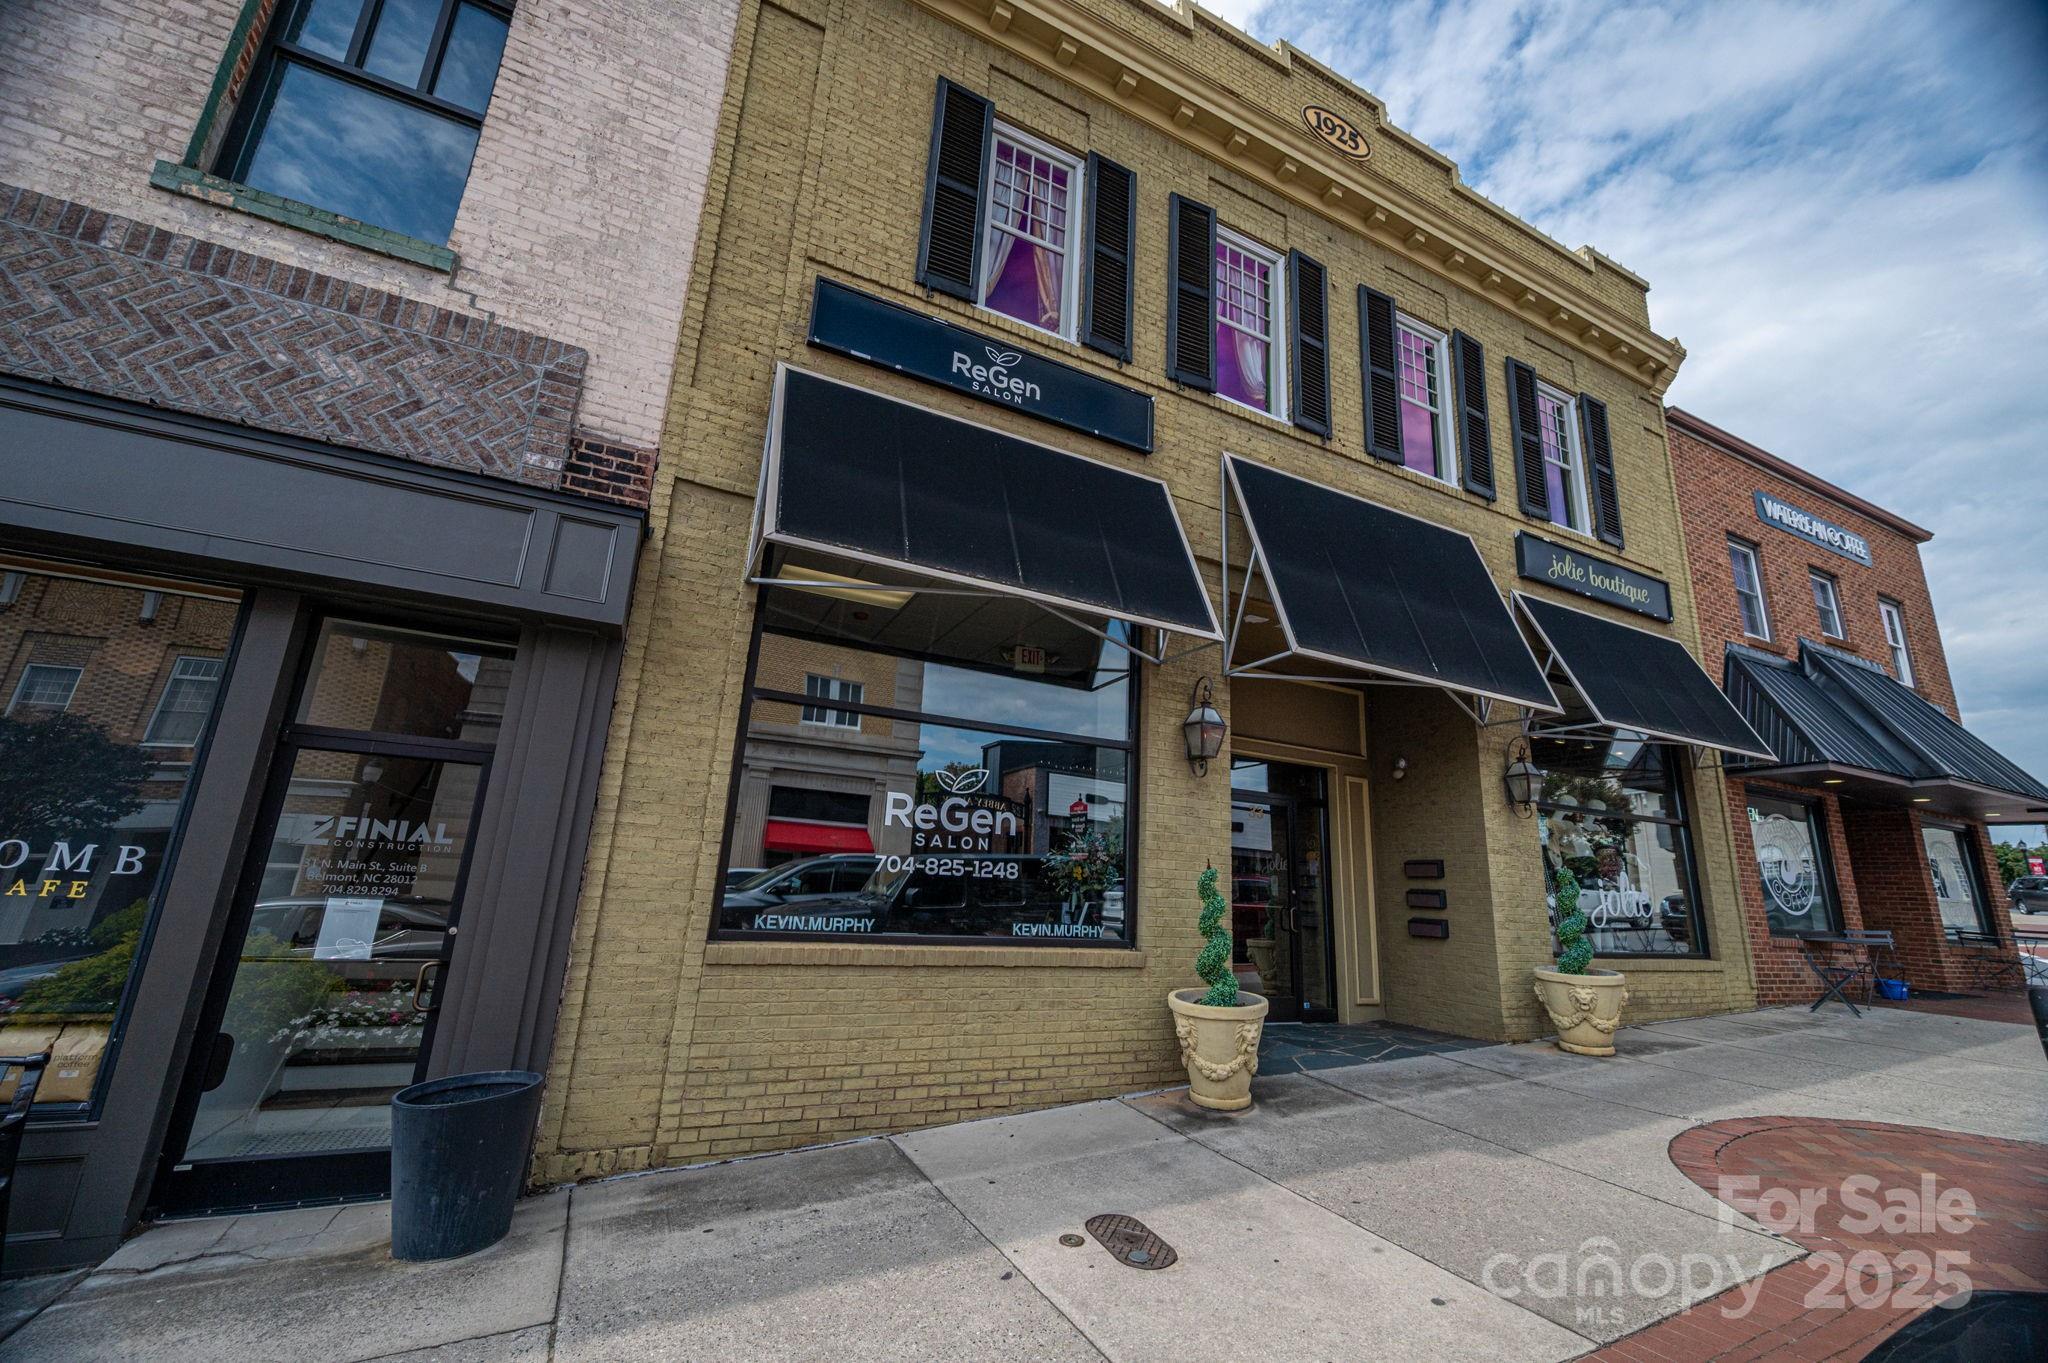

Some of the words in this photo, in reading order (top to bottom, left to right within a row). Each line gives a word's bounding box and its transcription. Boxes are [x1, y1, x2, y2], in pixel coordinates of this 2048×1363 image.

[1314, 111, 1359, 150] 1925
[952, 351, 1040, 400] ReGen
[972, 381, 1022, 404] SALON
[1548, 555, 1586, 582] jolie
[1589, 565, 1649, 603] boutique
[1021, 648, 1040, 665] EXIT
[884, 791, 1016, 836] ReGen
[335, 815, 453, 844] FINIAL
[333, 839, 451, 853] CONSTRUCTION
[914, 832, 989, 850] SALON
[321, 859, 333, 869] N.
[337, 860, 366, 870] Main
[388, 862, 417, 873] Suite
[419, 864, 428, 872] B
[875, 855, 1019, 880] 704-825-1248
[363, 873, 382, 883] NC
[383, 874, 417, 884] 28012
[322, 884, 399, 896] 704.829.8294
[754, 914, 875, 932] KEVIN.MURPHY
[1012, 923, 1104, 938] KEVIN.MURPHY
